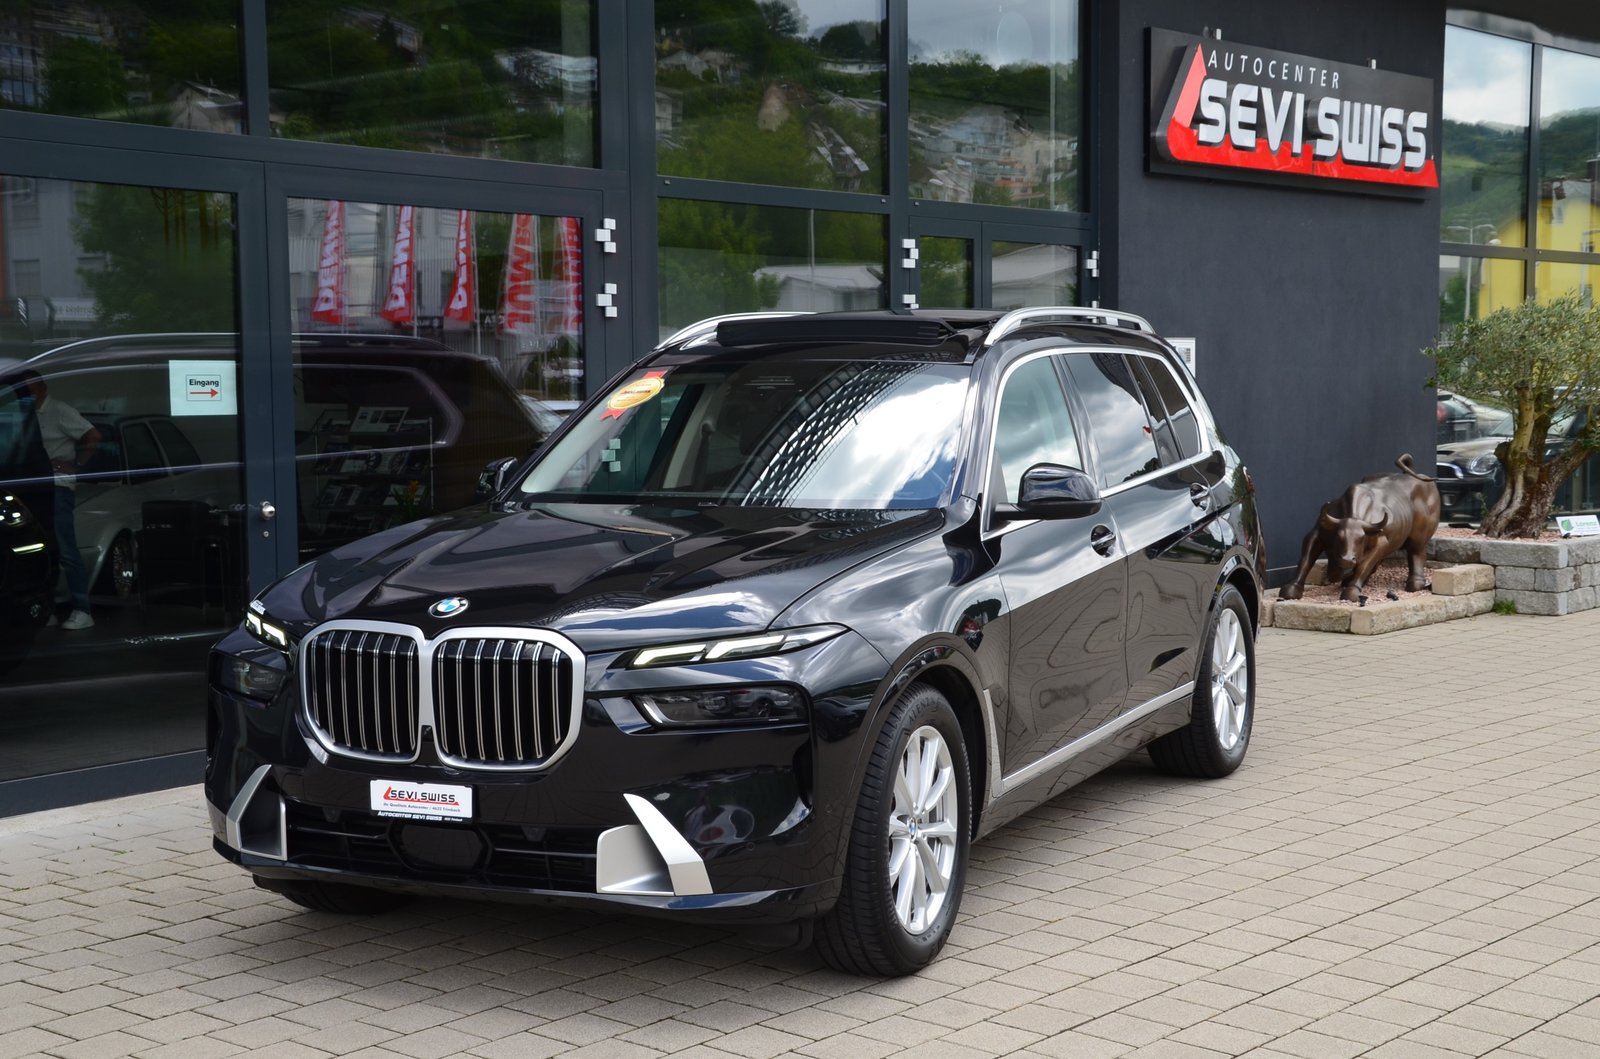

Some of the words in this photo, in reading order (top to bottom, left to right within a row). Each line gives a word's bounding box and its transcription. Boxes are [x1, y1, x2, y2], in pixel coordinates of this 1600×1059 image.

[1208, 49, 1340, 89] AUTOCENTER
[1197, 78, 1305, 154] SEVI
[1314, 96, 1428, 169] SWISS
[189, 379, 219, 387] Eingang
[391, 790, 417, 799] SEVI
[421, 792, 455, 802] SWISS
